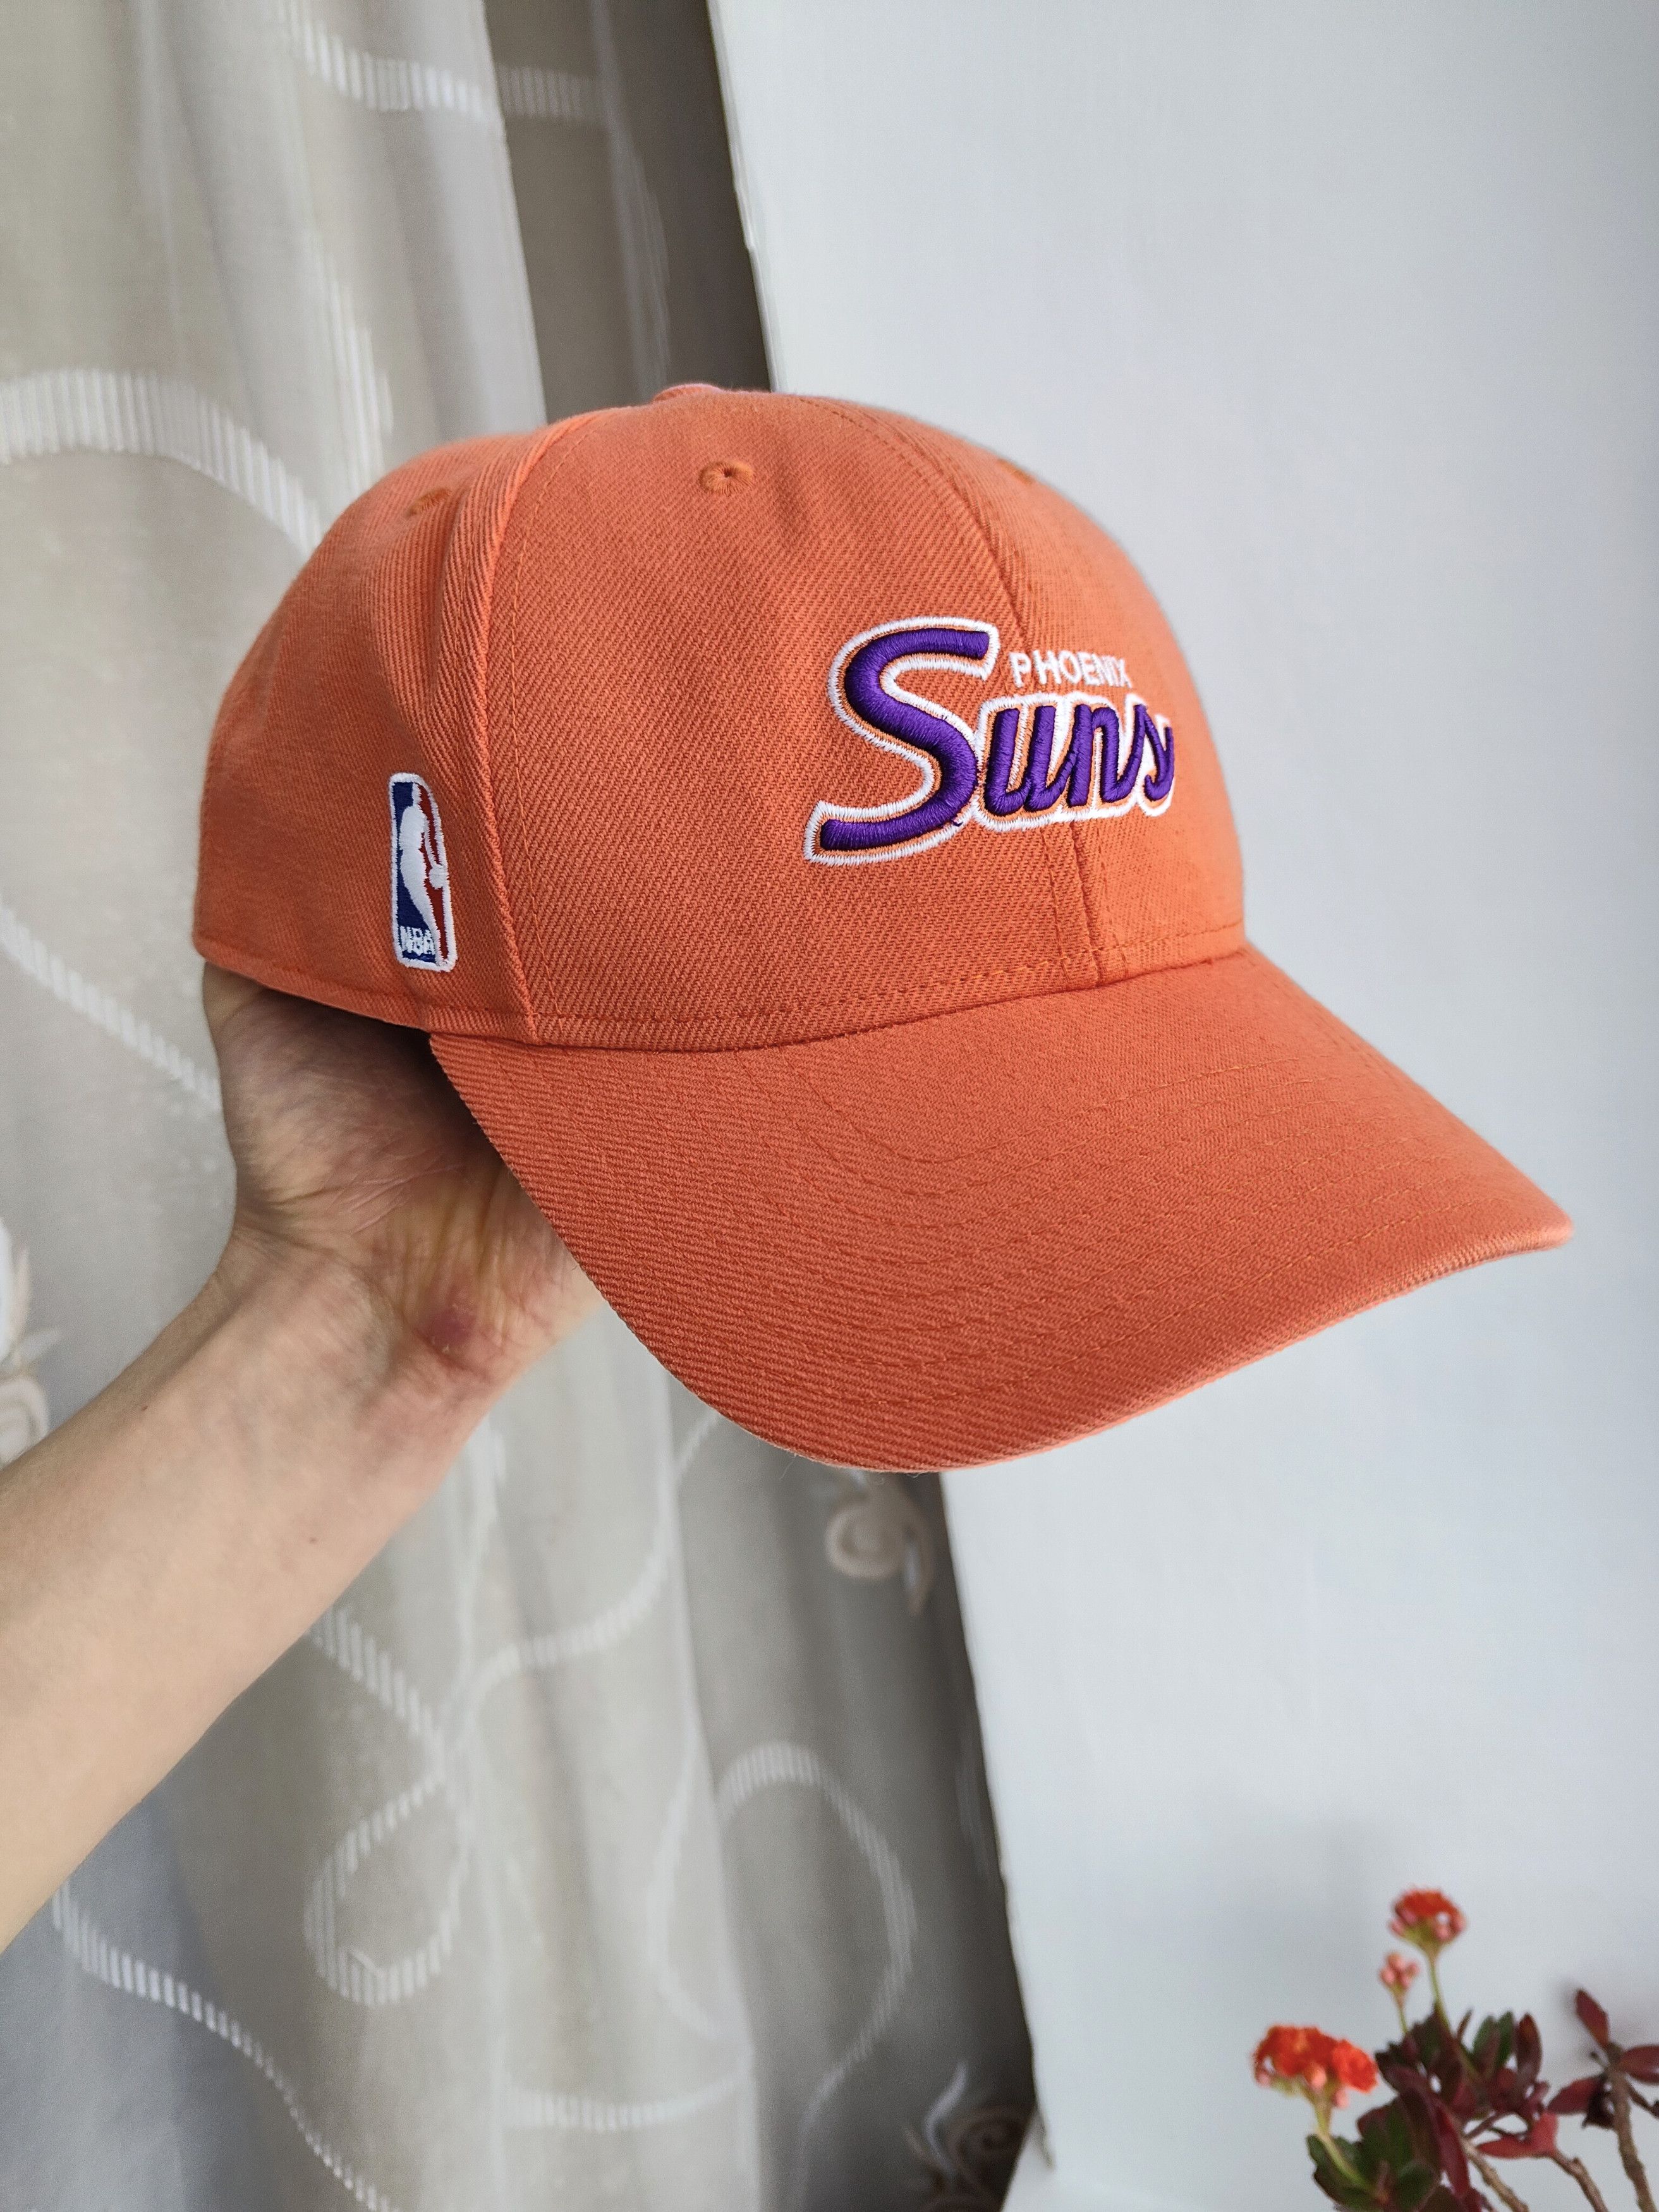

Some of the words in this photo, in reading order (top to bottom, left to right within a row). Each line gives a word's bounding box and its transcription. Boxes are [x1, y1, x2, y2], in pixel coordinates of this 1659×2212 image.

[1009, 649, 1133, 689] PHOENIX
[817, 624, 1176, 853] Suns
[399, 925, 436, 956] NBA
